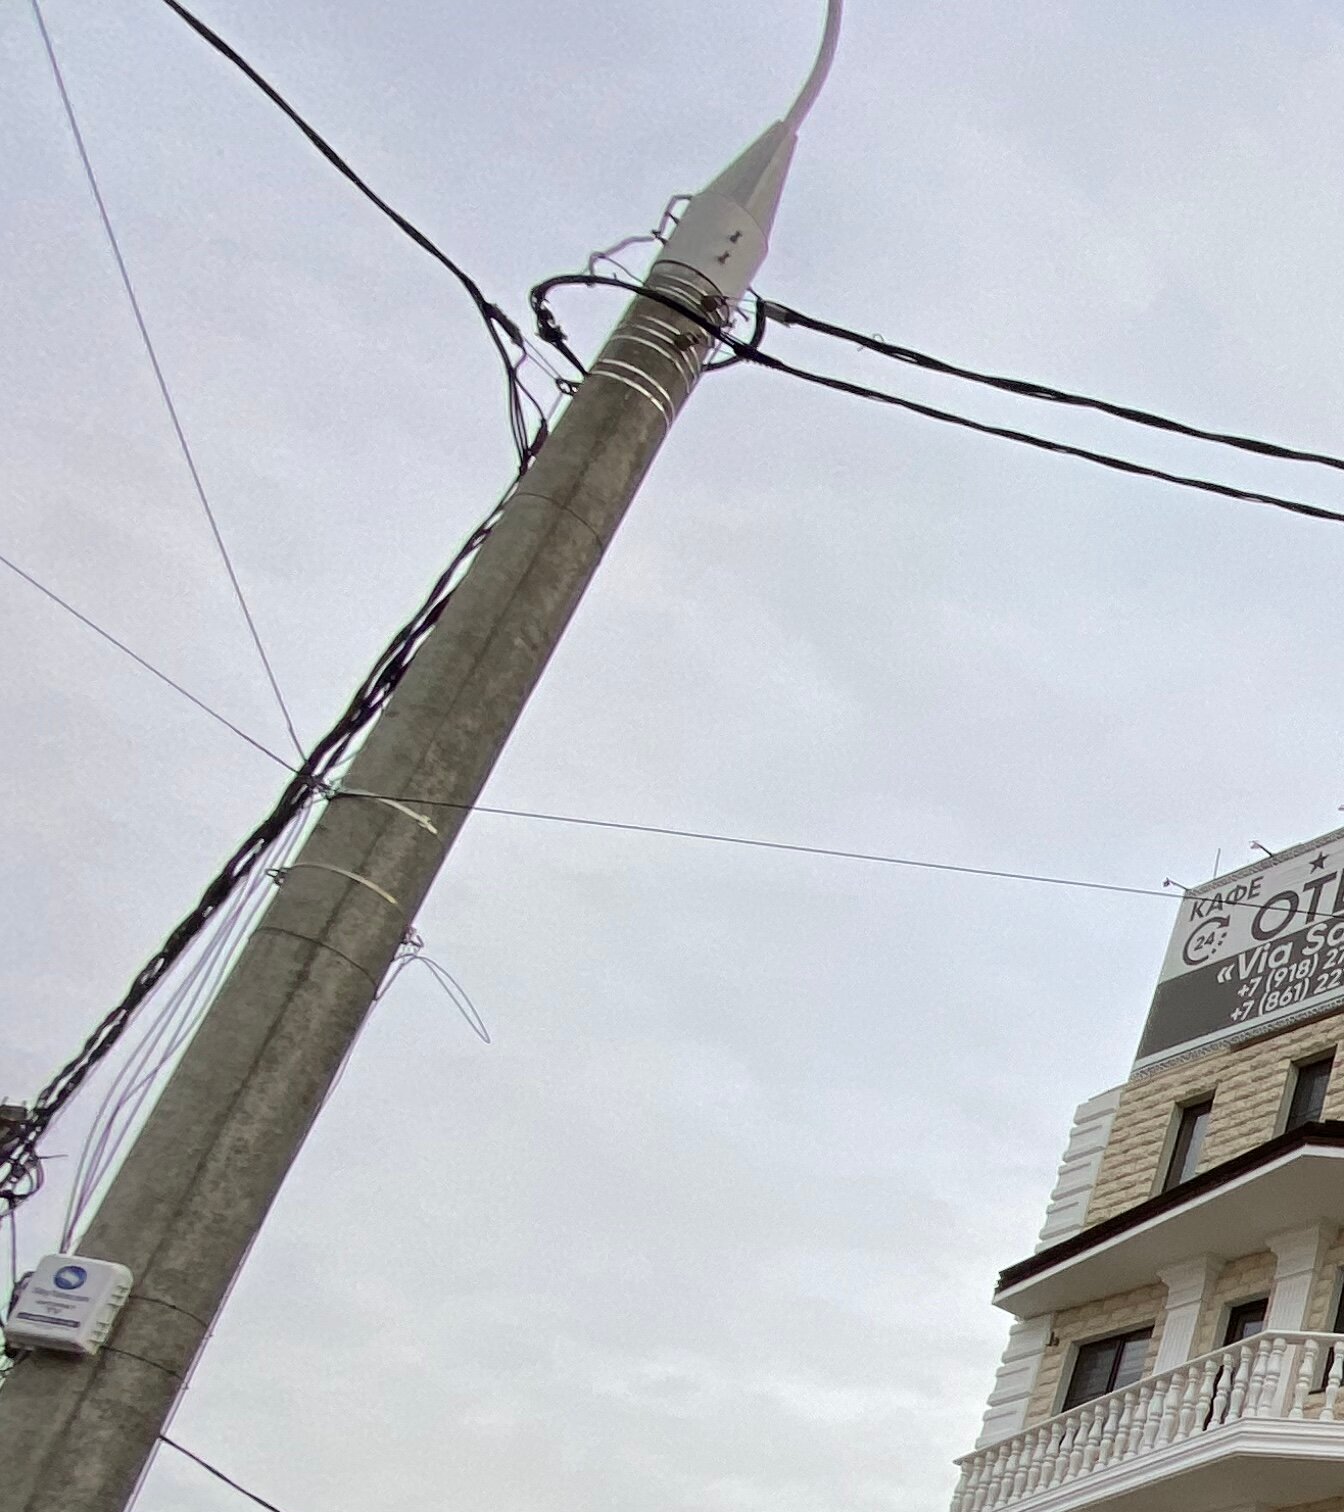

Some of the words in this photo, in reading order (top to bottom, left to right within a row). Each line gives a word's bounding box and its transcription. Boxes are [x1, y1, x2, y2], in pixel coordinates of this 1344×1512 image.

[1190, 876, 1264, 922] КАФЕ
[1194, 931, 1215, 951] 24
[1216, 942, 1293, 984] «Via
[1237, 976, 1263, 998] +7
[1266, 953, 1319, 993] (918)
[1230, 1001, 1255, 1022] +7
[1258, 978, 1310, 1017] (861)
